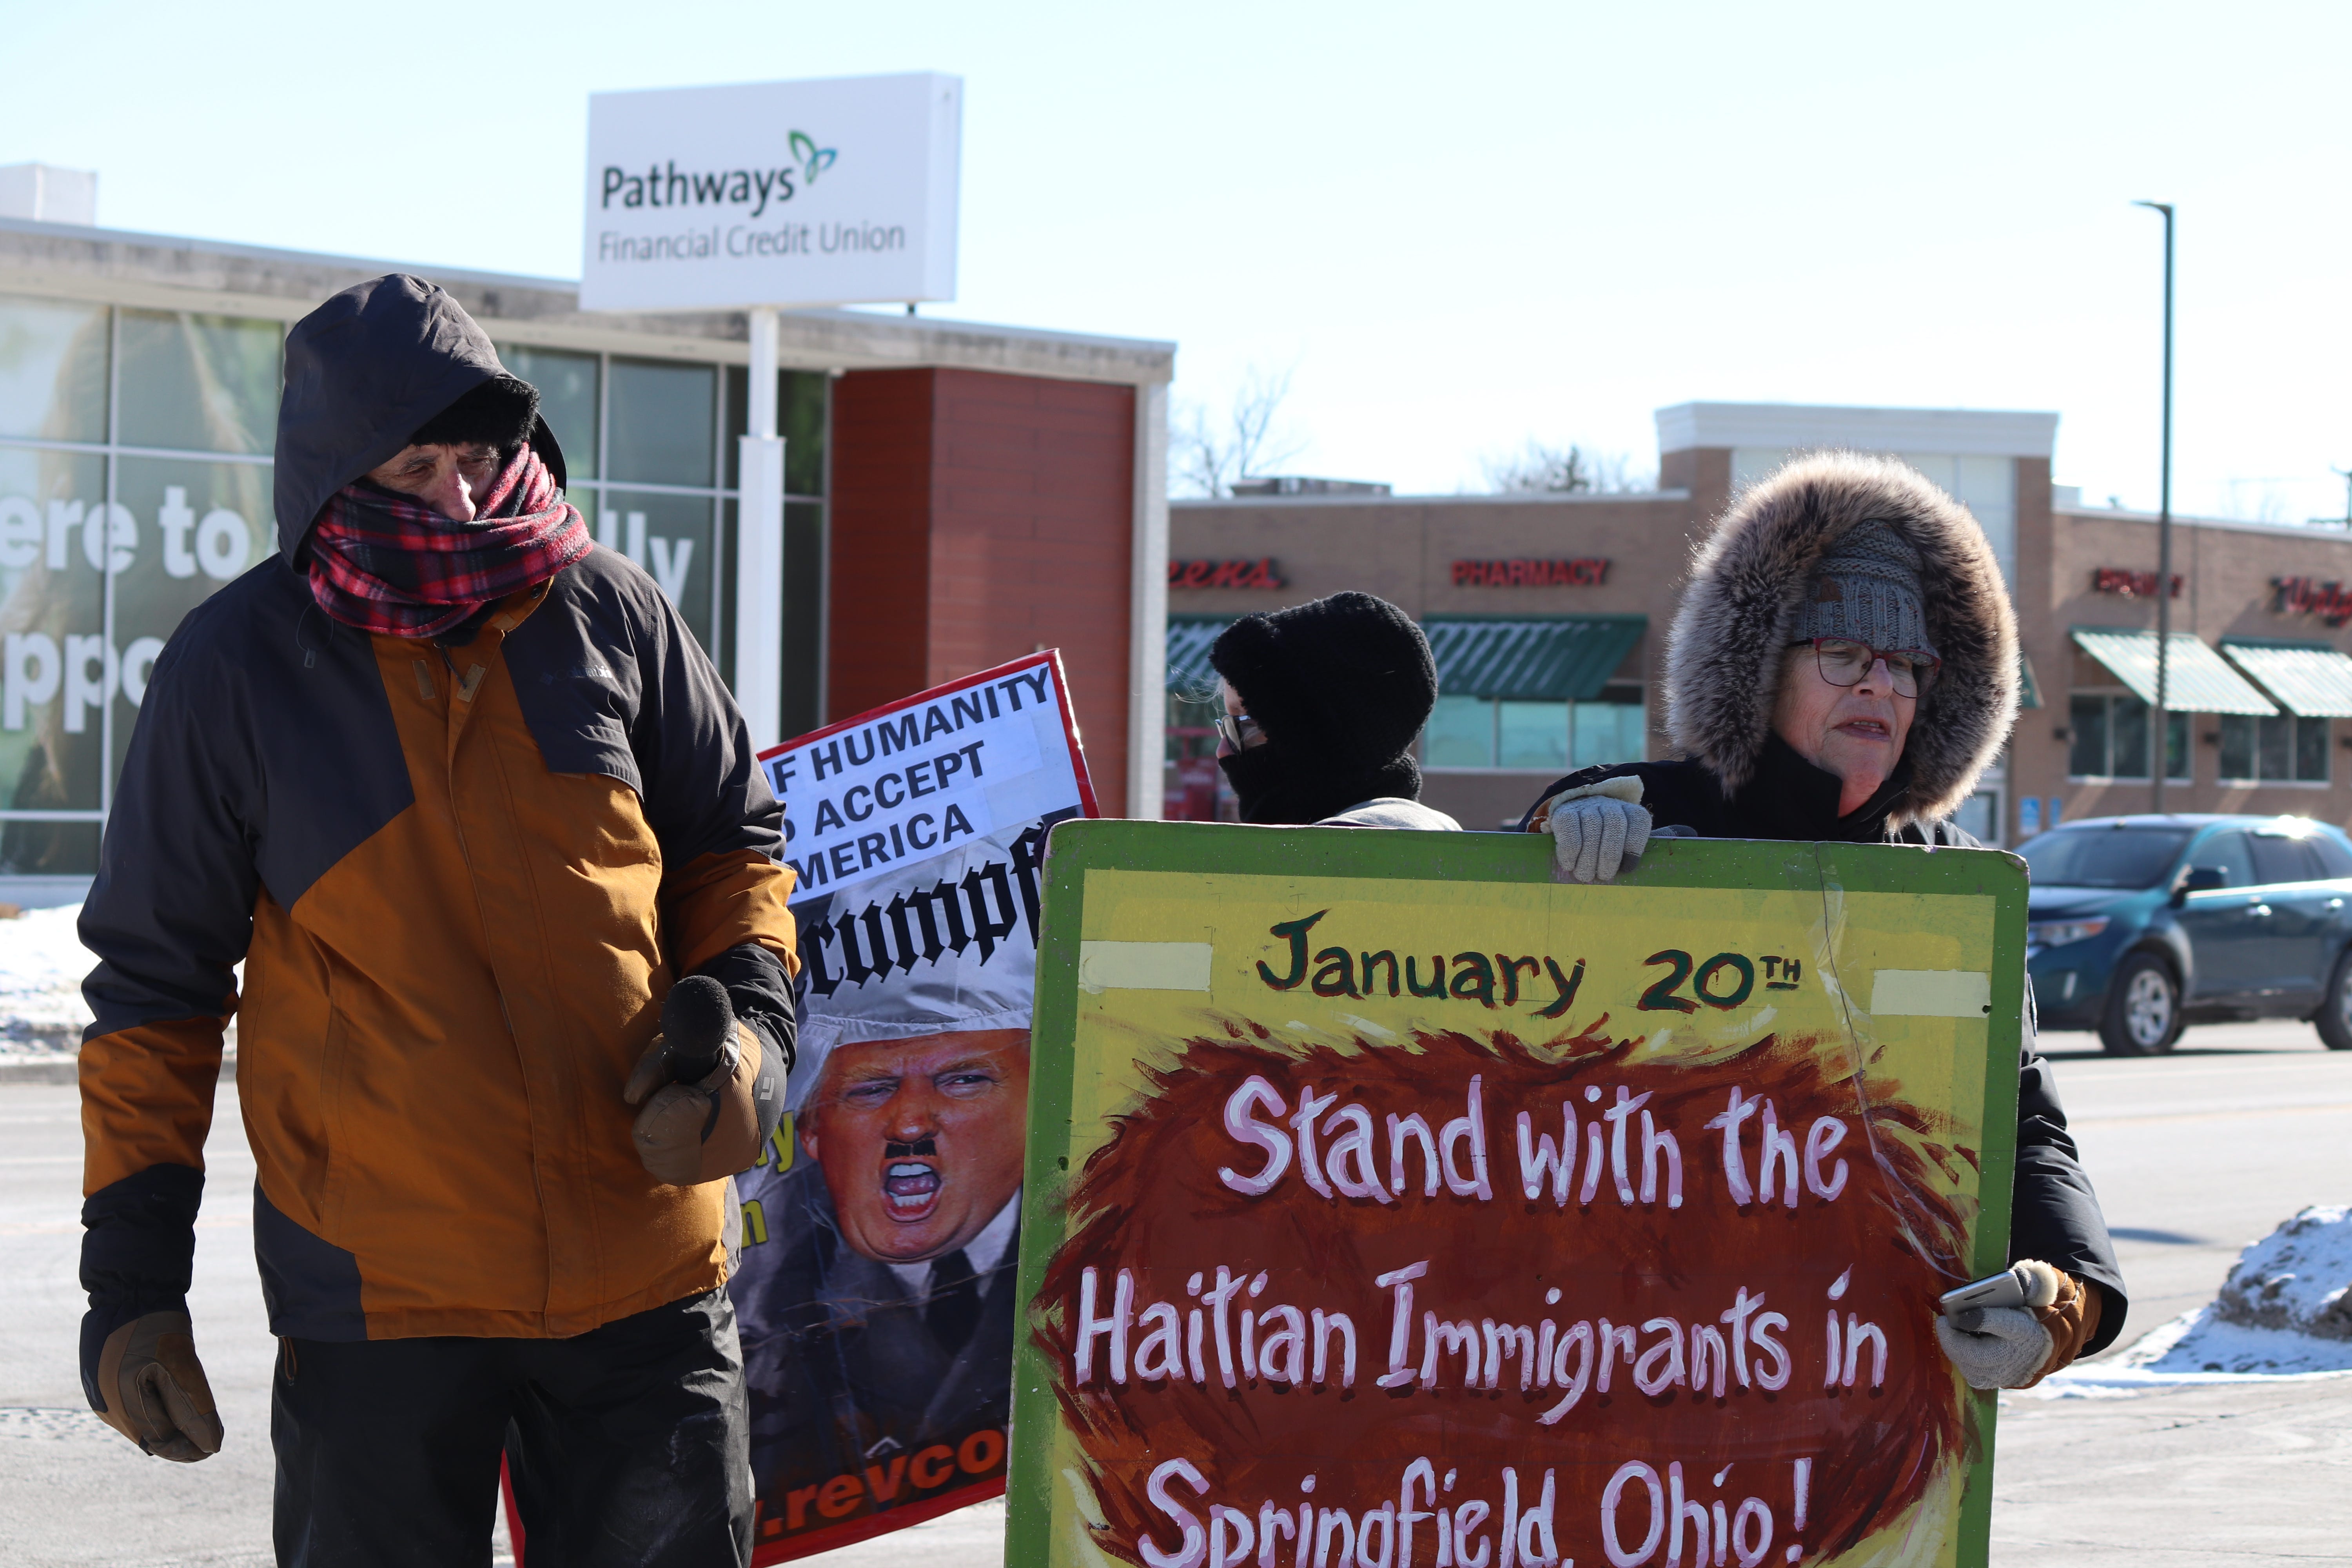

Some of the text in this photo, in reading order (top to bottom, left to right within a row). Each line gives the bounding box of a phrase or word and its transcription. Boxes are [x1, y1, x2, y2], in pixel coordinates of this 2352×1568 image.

[599, 220, 906, 262] Financial Credit Union
[602, 161, 795, 218] Pathways
[159, 485, 250, 581] to
[1452, 558, 1607, 586] PHARMACY
[555, 664, 613, 681] Columbia
[764, 666, 1049, 794] F HUMANITY
[814, 740, 985, 837] ACCEPT
[795, 821, 1045, 1006] rumpf
[1256, 908, 1801, 1018] January 20TH
[1217, 1073, 1848, 1209] Stand with the
[1075, 1260, 1887, 1425] Haitian Immigrants in
[755, 1429, 1005, 1537] .revco
[1601, 1457, 1812, 1568] Ohio!
